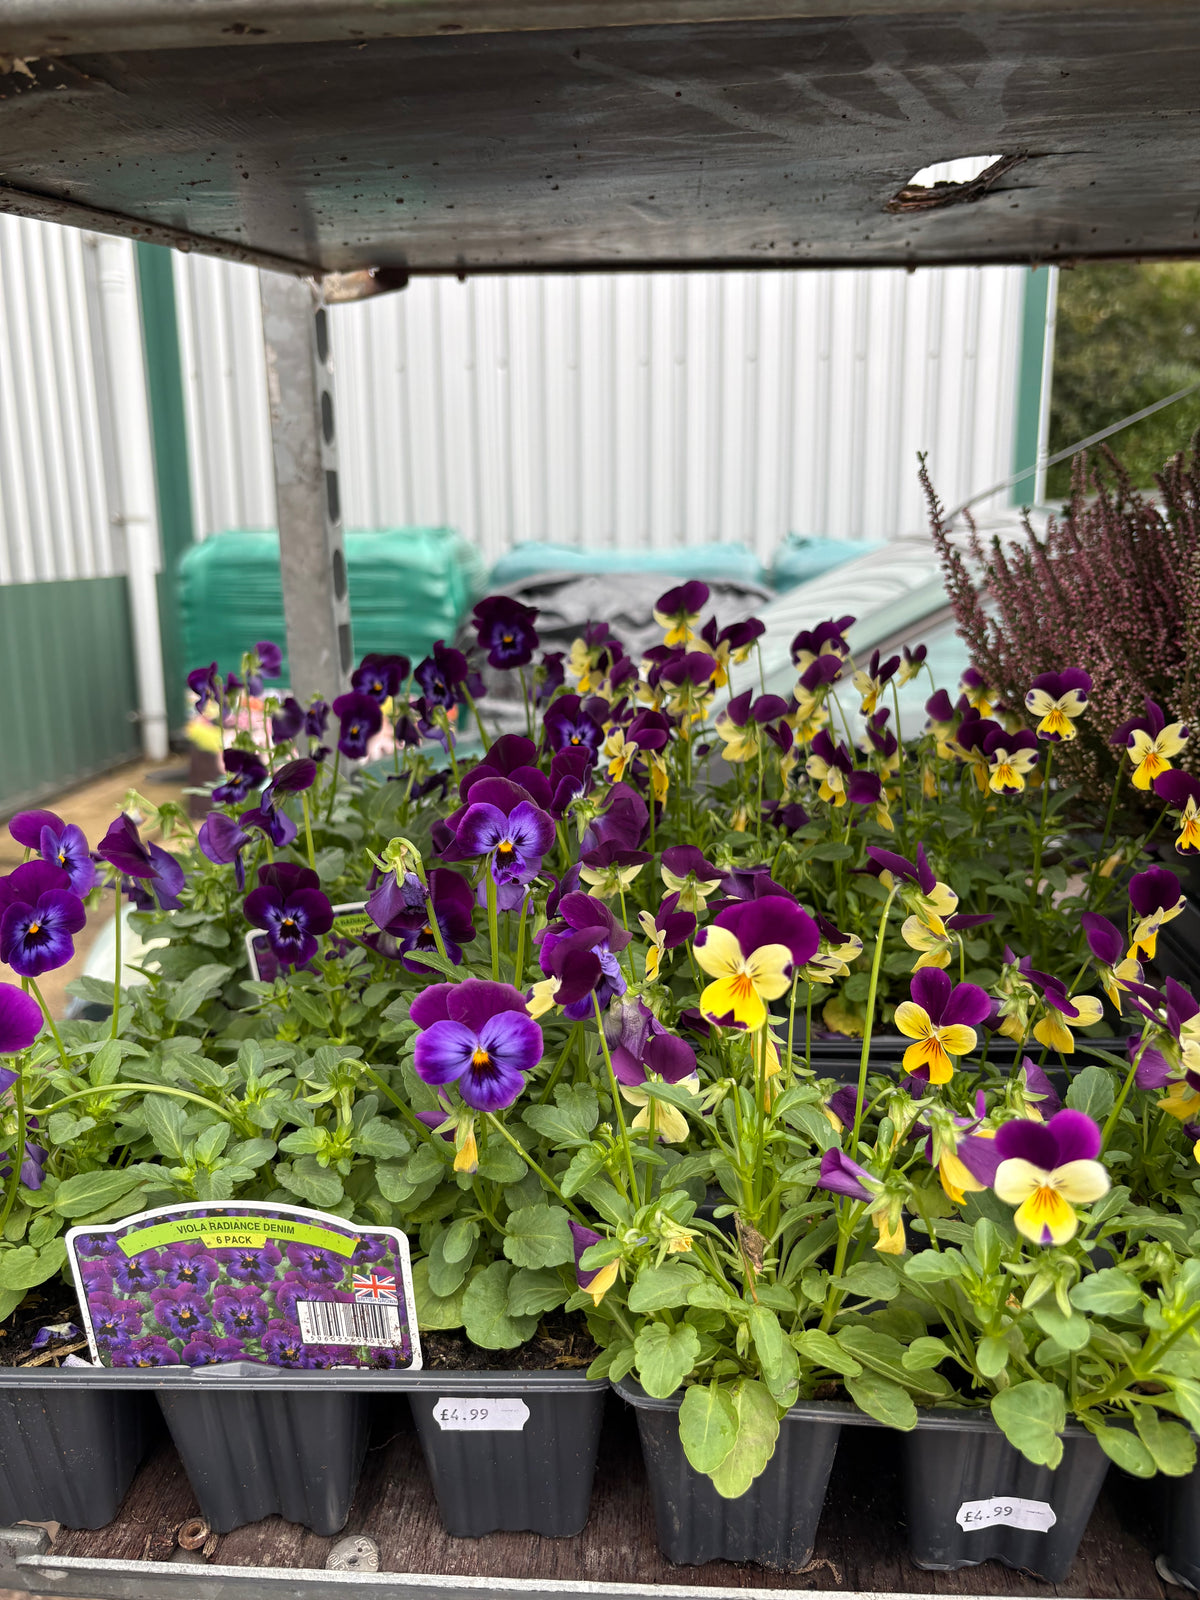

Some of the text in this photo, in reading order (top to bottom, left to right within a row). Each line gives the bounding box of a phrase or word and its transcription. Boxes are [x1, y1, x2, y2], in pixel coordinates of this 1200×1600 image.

[176, 1221, 295, 1235] VIOLA RADIANCE DENIM
[216, 1235, 253, 1245] 6 PACK
[440, 1408, 489, 1421] £4.99
[963, 1505, 1013, 1523] £4.99
